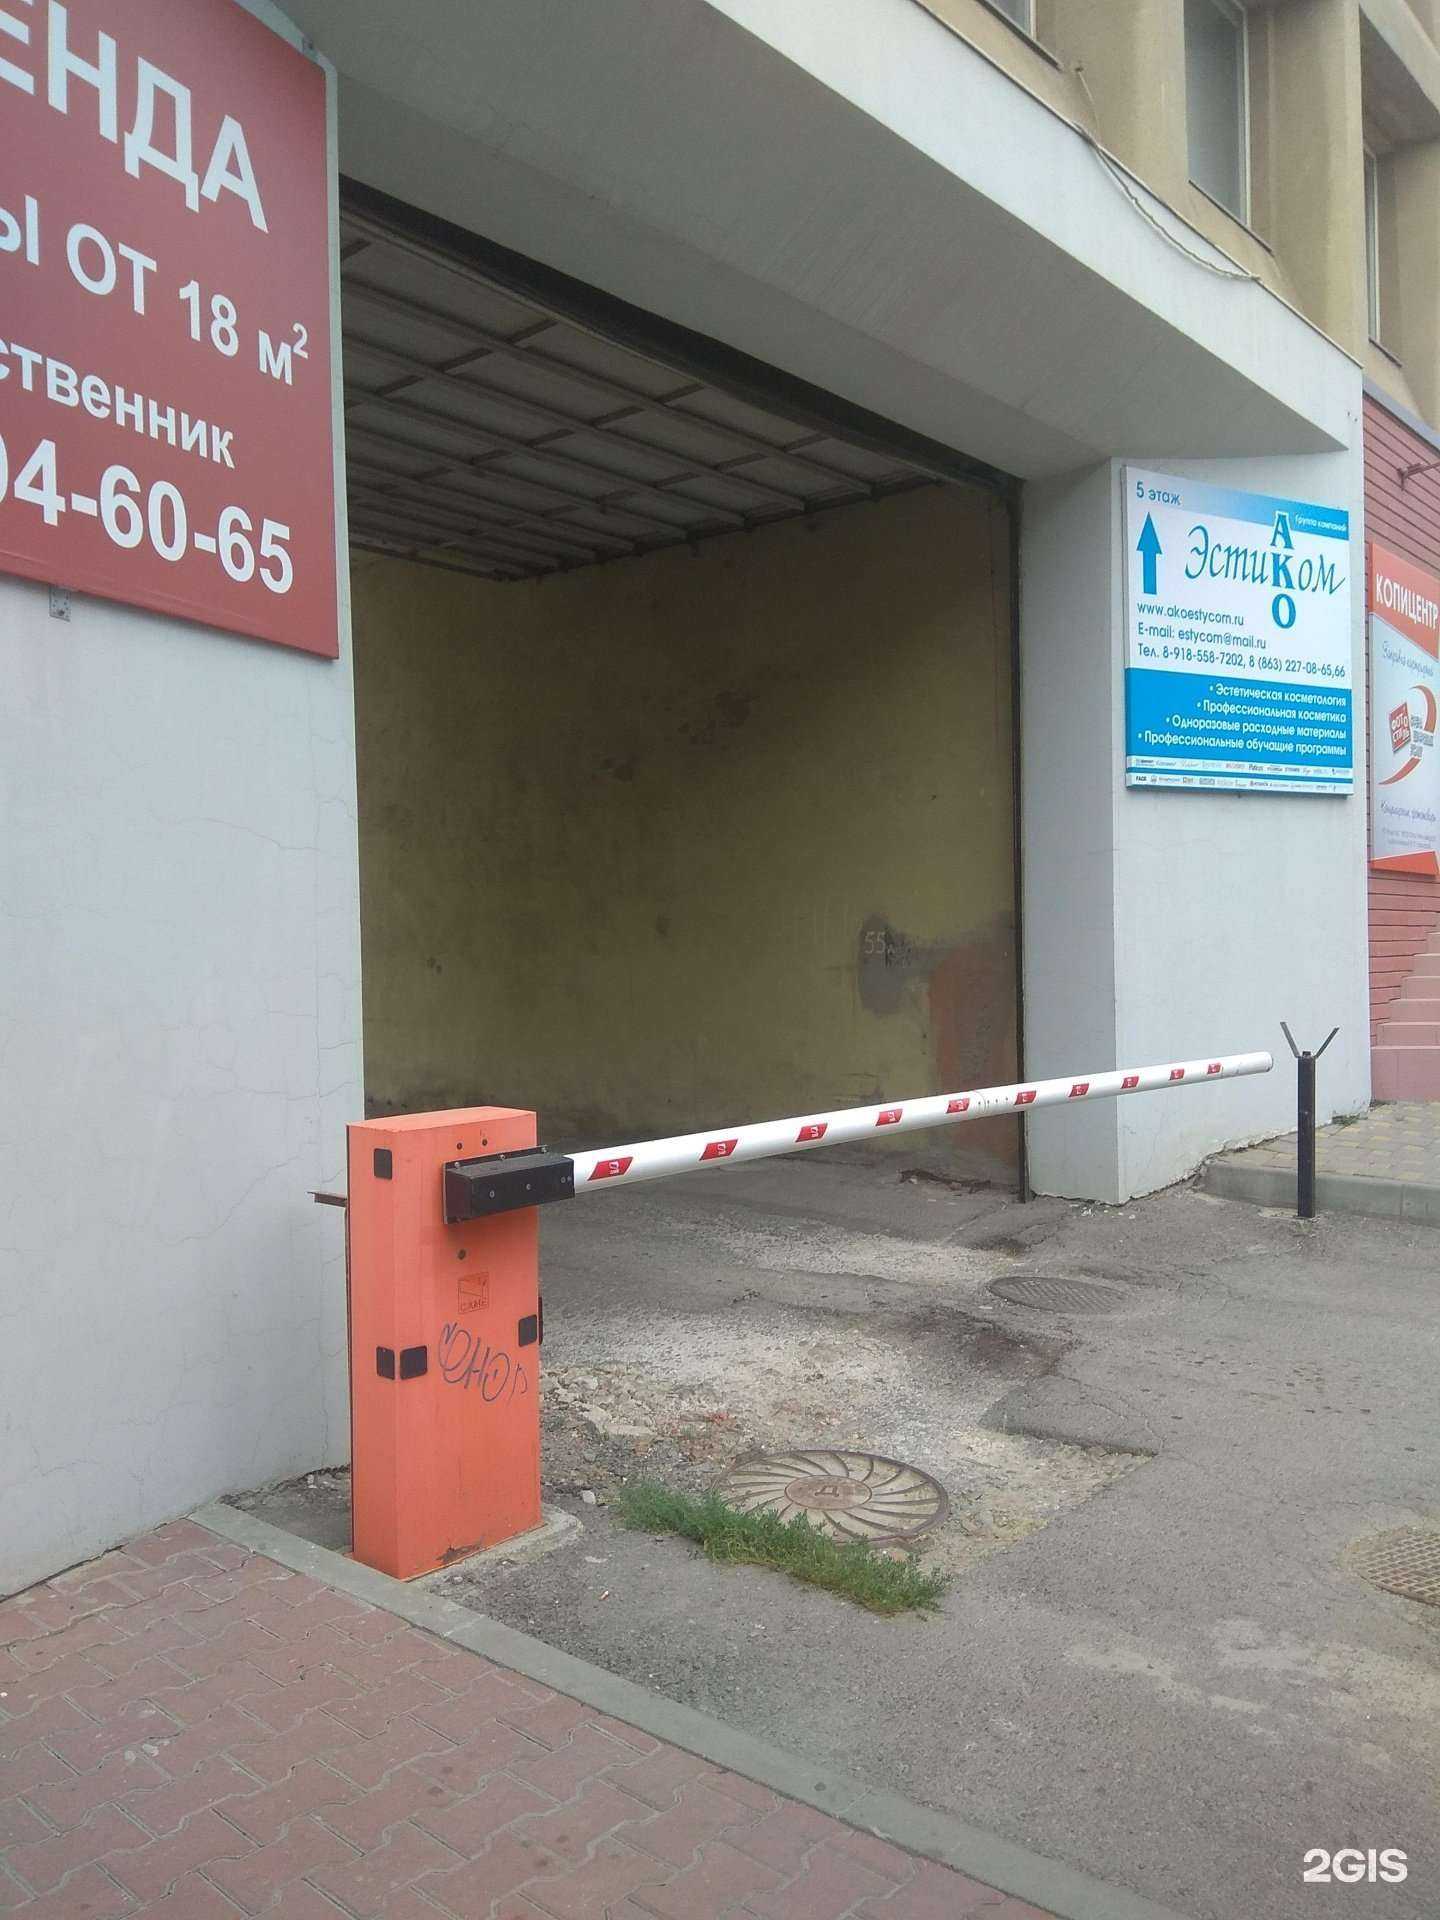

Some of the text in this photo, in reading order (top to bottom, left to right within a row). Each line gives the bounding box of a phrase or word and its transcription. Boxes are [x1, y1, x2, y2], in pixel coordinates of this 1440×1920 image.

[66, 223, 157, 316] ОТ
[179, 280, 239, 357] 18
[1136, 481, 1182, 505] 5 этаж
[0, 433, 294, 594] 4-60-65
[1137, 602, 1244, 626] www.akoestycom.ru
[1376, 573, 1439, 630] КОПИЦЕНТР
[1138, 623, 1267, 649] E-mail: estycom@mail.ru
[1138, 643, 1346, 679] Тел. 8-918-558-7202, 8 (863) 227-08-65,66
[1215, 683, 1347, 707] Эстетическая косметология
[1203, 700, 1347, 723] Профессиональная косметика
[1172, 714, 1347, 740] Одноразовые расходные материалы
[1144, 730, 1244, 750] Профессиональные
[1296, 744, 1347, 757] программы
